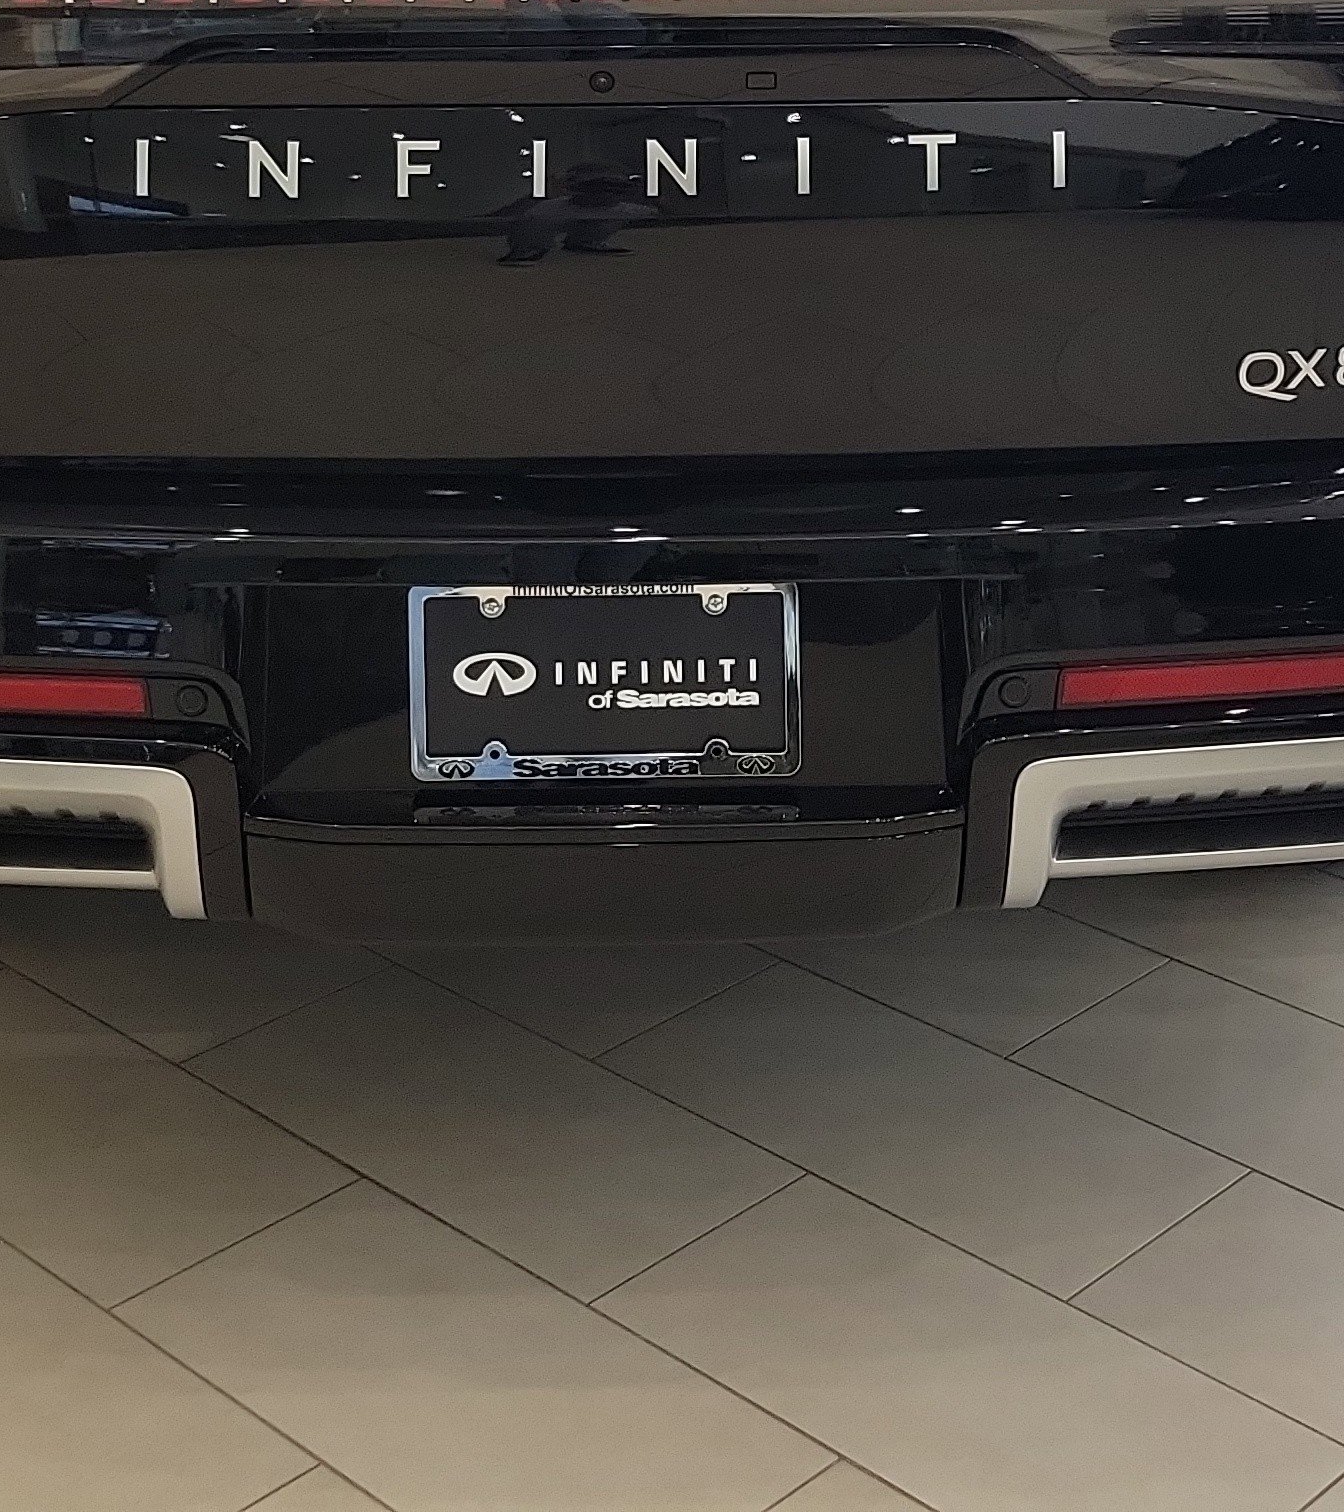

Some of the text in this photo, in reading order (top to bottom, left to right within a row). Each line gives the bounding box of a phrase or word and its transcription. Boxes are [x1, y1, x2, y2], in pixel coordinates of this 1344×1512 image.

[134, 129, 1067, 199] INFINITI
[554, 657, 758, 686] INFINITI
[587, 688, 760, 709] of Sarasota
[512, 757, 702, 778] Sarasota
